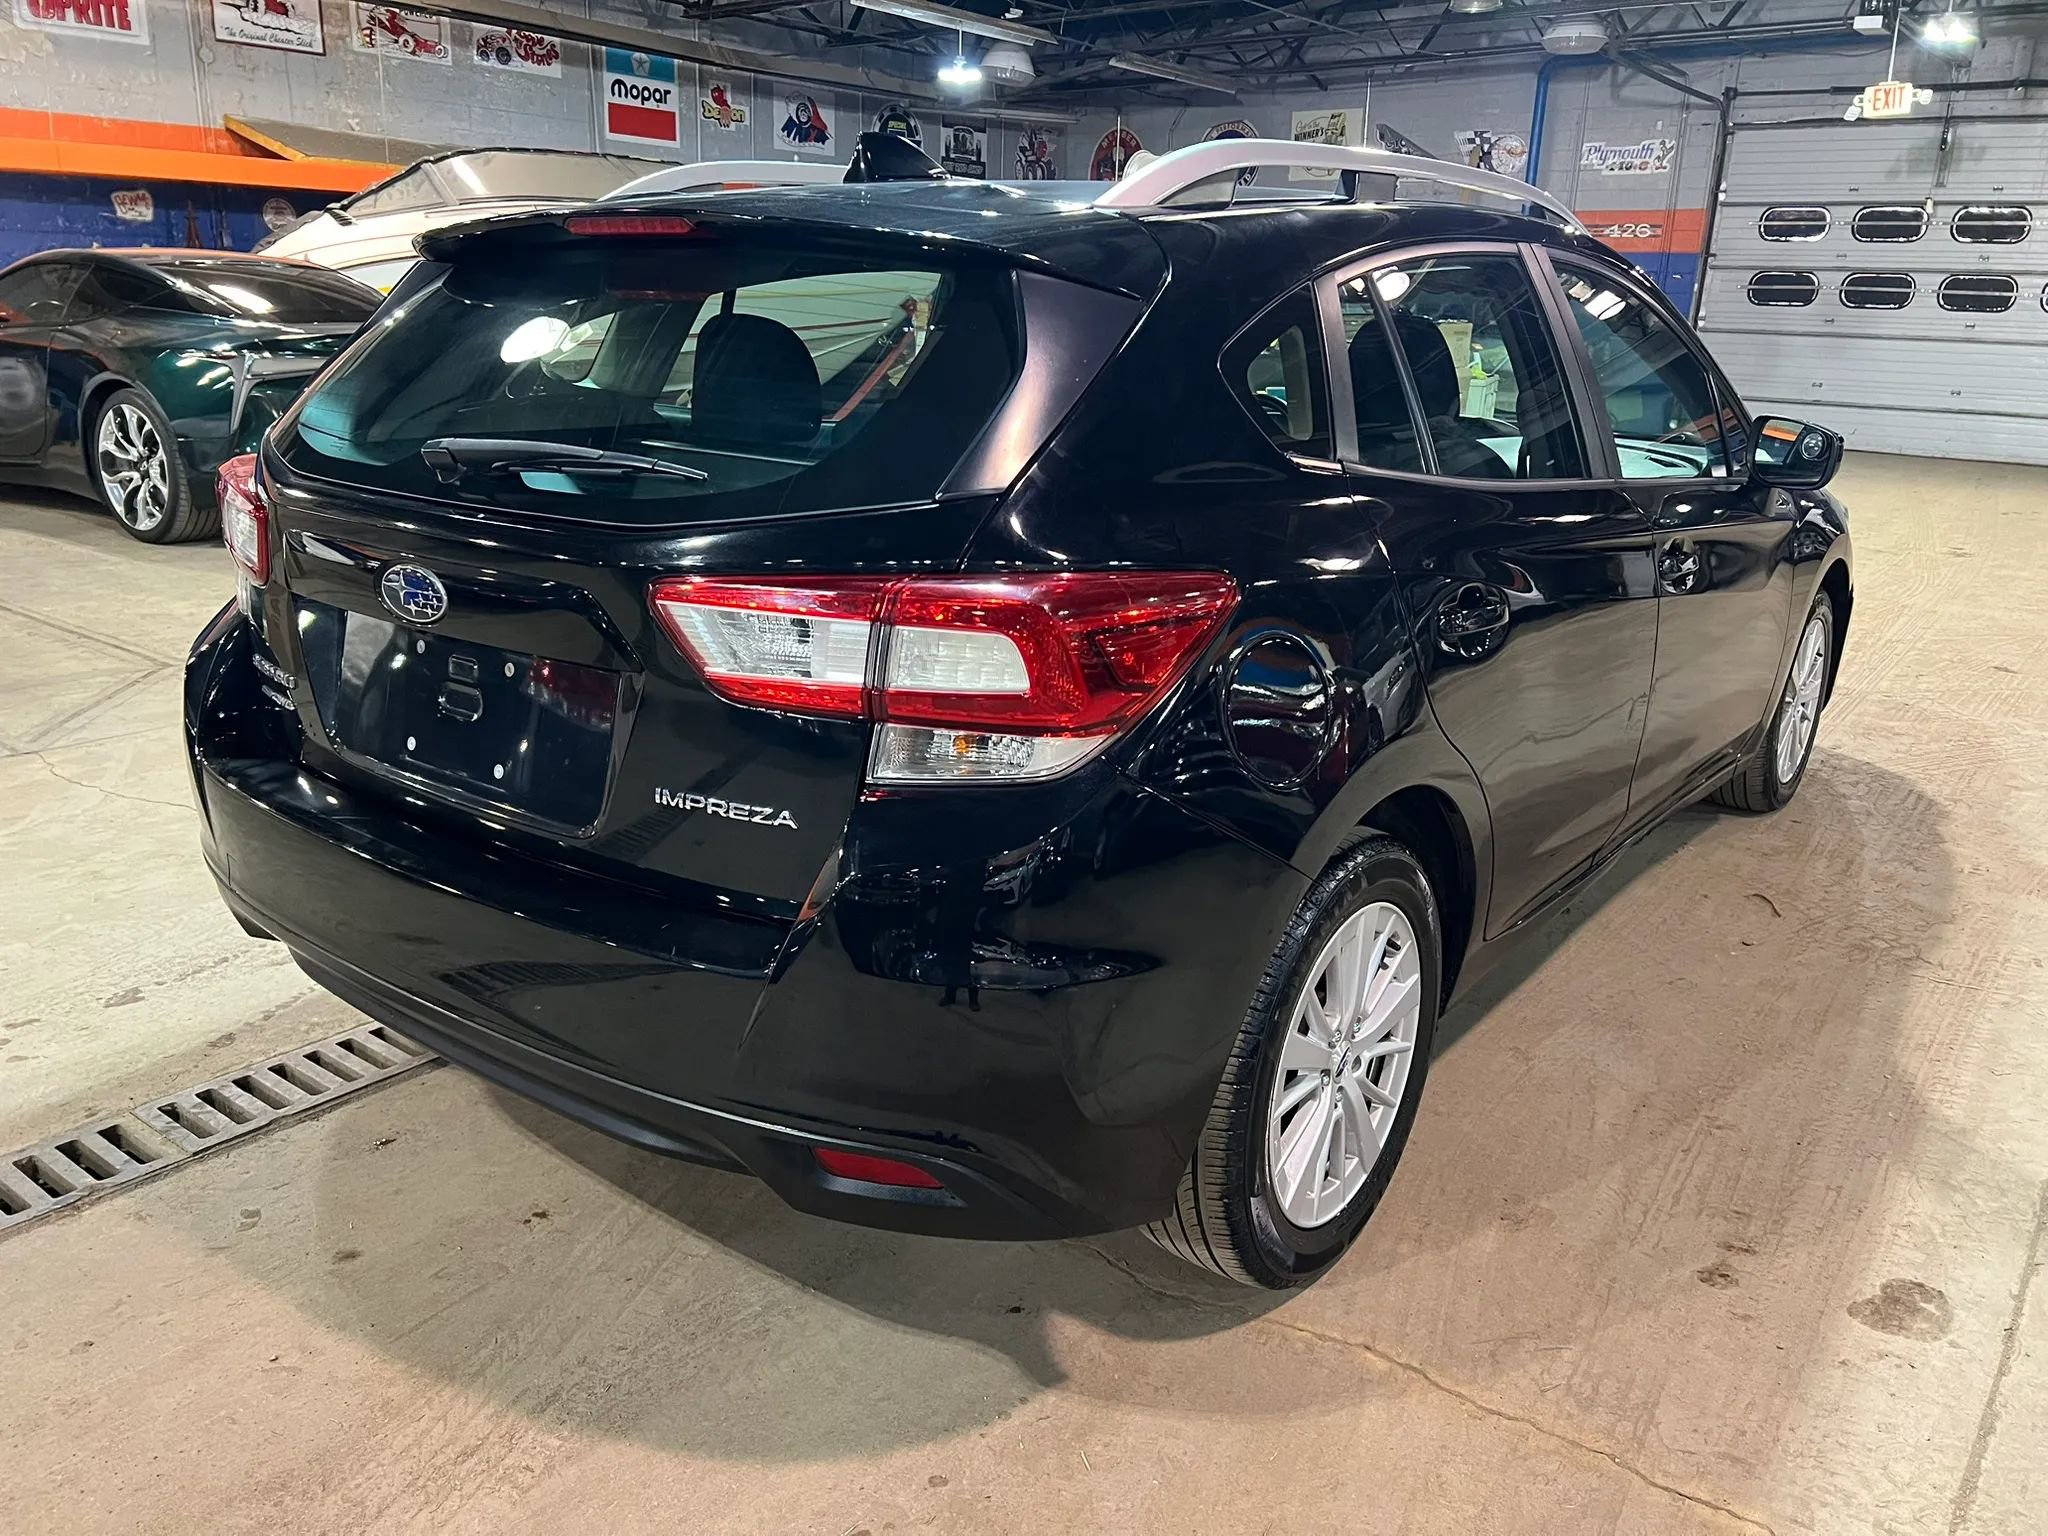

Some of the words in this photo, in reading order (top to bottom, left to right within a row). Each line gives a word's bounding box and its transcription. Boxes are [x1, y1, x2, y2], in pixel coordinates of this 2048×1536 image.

[239, 29, 267, 42] Original
[611, 78, 672, 105] Mopar
[1873, 86, 1905, 111] EXIT
[1585, 143, 1655, 166] Plymouth
[1606, 224, 1651, 238] 426
[655, 787, 799, 829] IMPREZA
